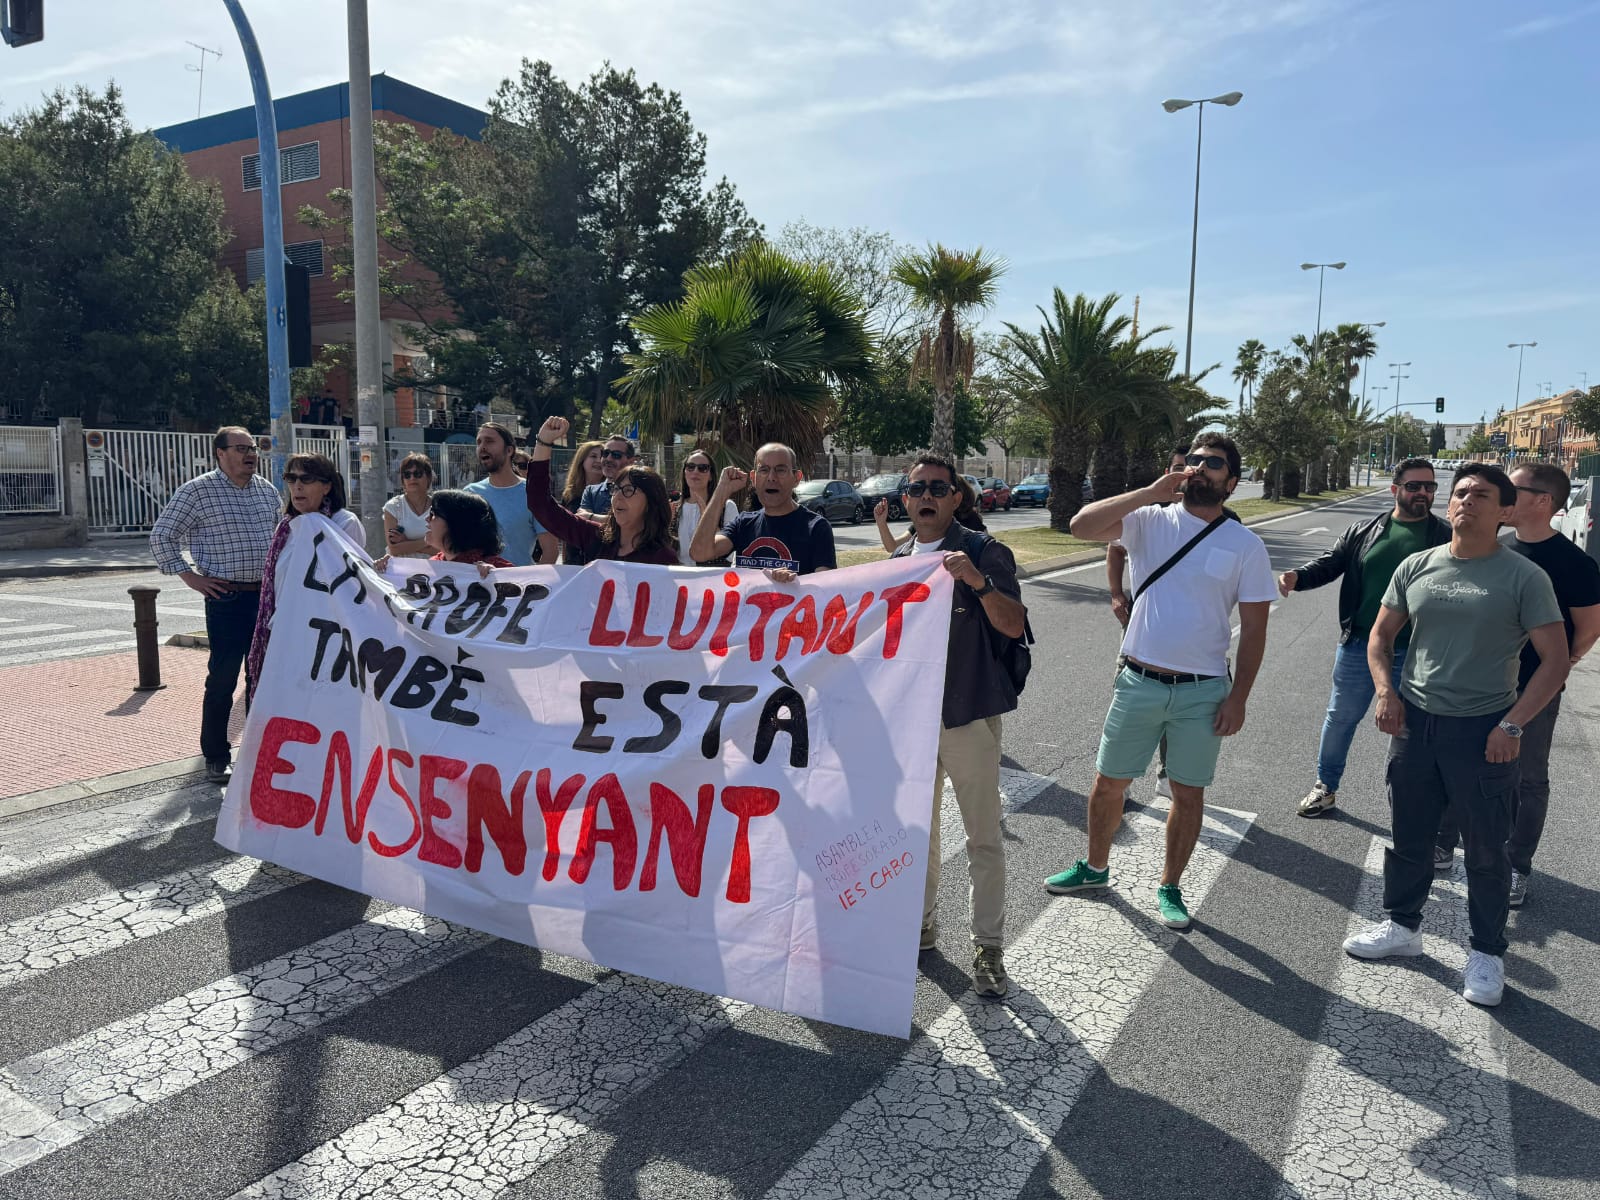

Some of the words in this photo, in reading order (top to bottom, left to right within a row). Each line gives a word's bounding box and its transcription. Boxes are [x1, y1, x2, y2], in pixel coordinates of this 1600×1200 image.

[303, 530, 367, 605] LA
[760, 559, 773, 567] THE
[774, 561, 793, 569] GAP
[1421, 576, 1449, 594] Pepe
[1447, 581, 1489, 597] Jeans
[572, 664, 809, 768] ESTÀ
[250, 717, 780, 904] ENSENYANT
[815, 818, 884, 873] ASAMBLEA
[838, 881, 868, 911] IES
[870, 851, 914, 889] CABO
